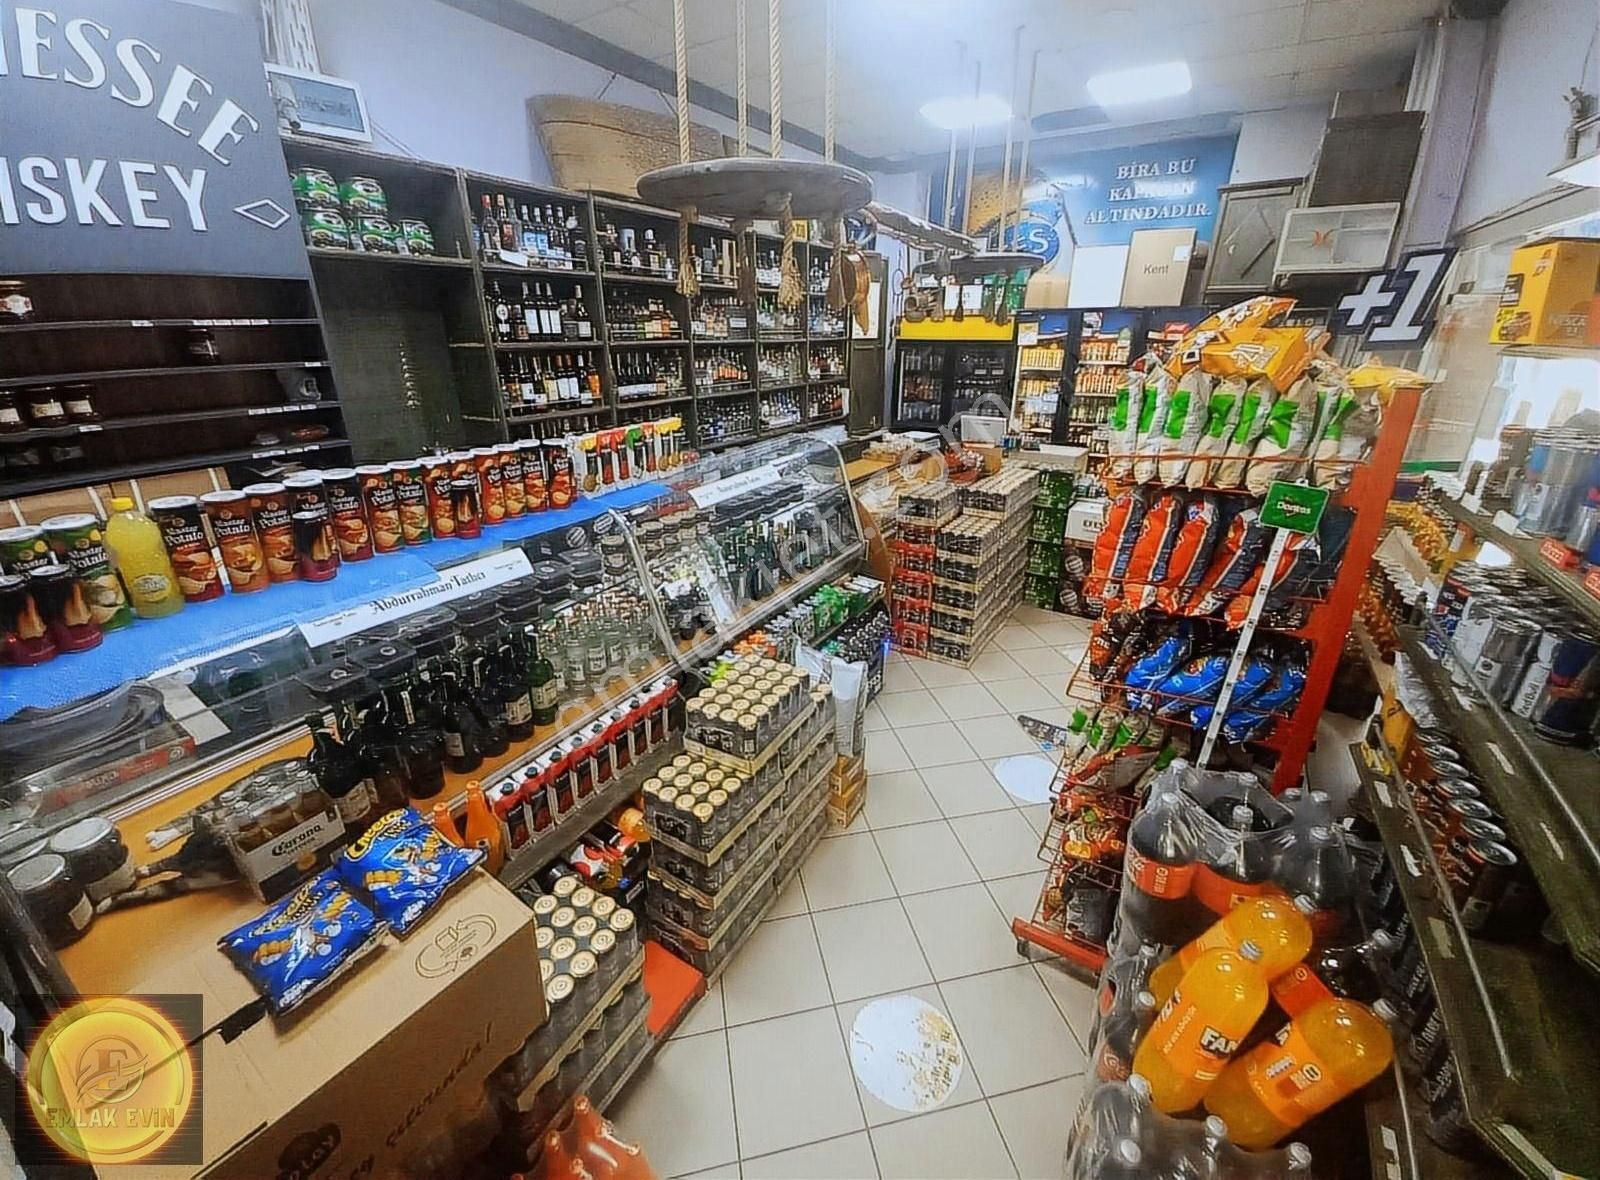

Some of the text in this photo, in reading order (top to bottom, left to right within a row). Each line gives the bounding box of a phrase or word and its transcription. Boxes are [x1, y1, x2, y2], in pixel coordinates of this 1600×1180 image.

[0, 7, 259, 166] ESSEE
[1166, 159, 1196, 175] BU
[1144, 264, 1169, 275] Kent
[271, 824, 323, 857] Corona
